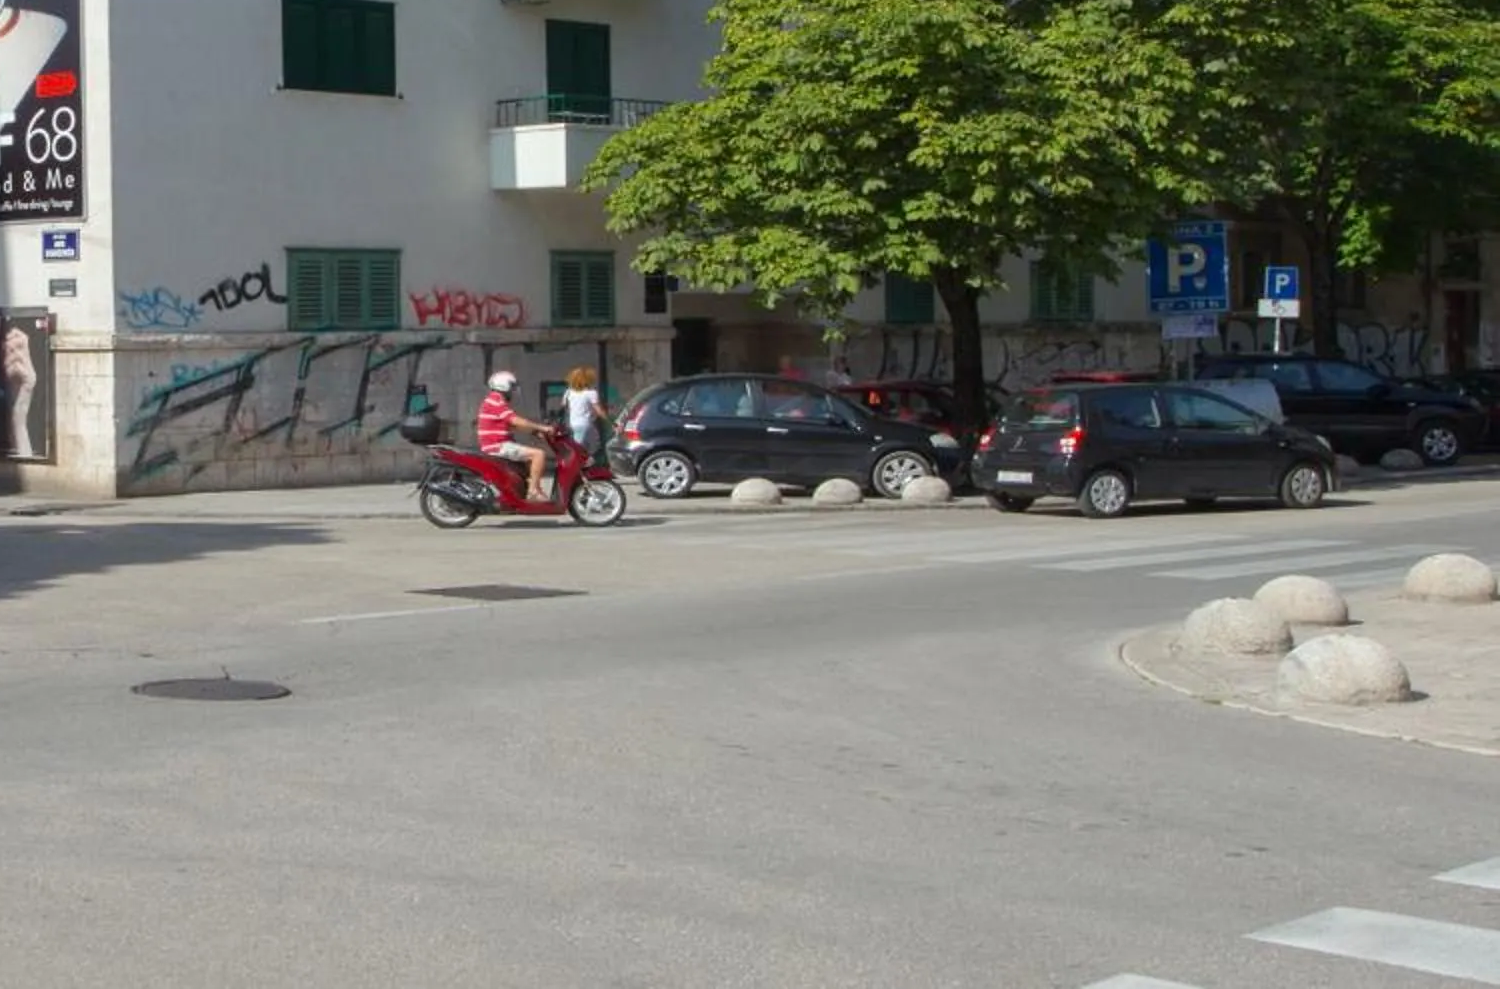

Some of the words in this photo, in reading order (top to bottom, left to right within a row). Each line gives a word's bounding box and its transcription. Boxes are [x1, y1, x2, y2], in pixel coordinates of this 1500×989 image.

[25, 106, 77, 163] 68
[23, 170, 36, 192] &
[45, 167, 76, 190] Me
[1168, 243, 1206, 293] P
[1275, 273, 1290, 294] P
